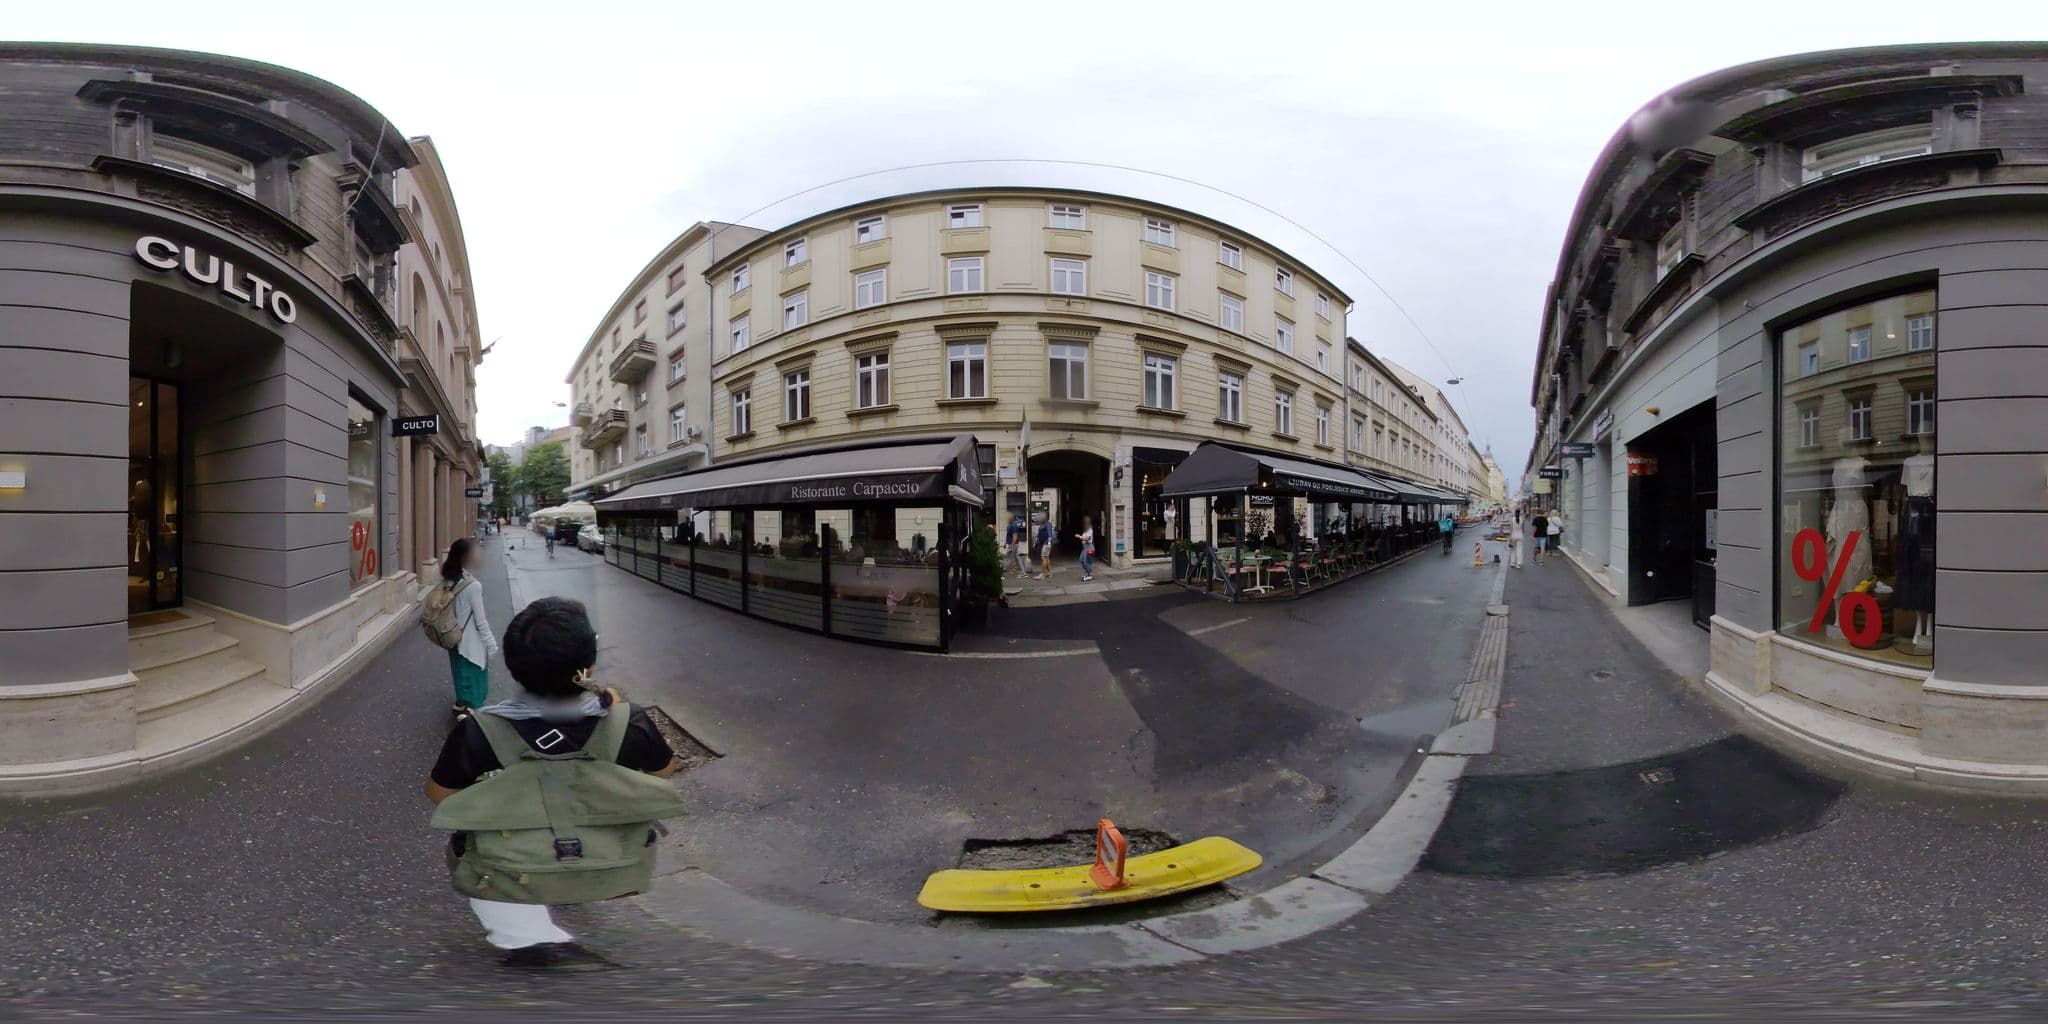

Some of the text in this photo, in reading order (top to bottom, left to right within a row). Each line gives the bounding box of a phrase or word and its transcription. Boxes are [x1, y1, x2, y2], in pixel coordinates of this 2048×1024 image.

[135, 236, 297, 324] CULTO
[402, 420, 434, 430] CULTO
[791, 479, 920, 499] Ristorante Carpaccio
